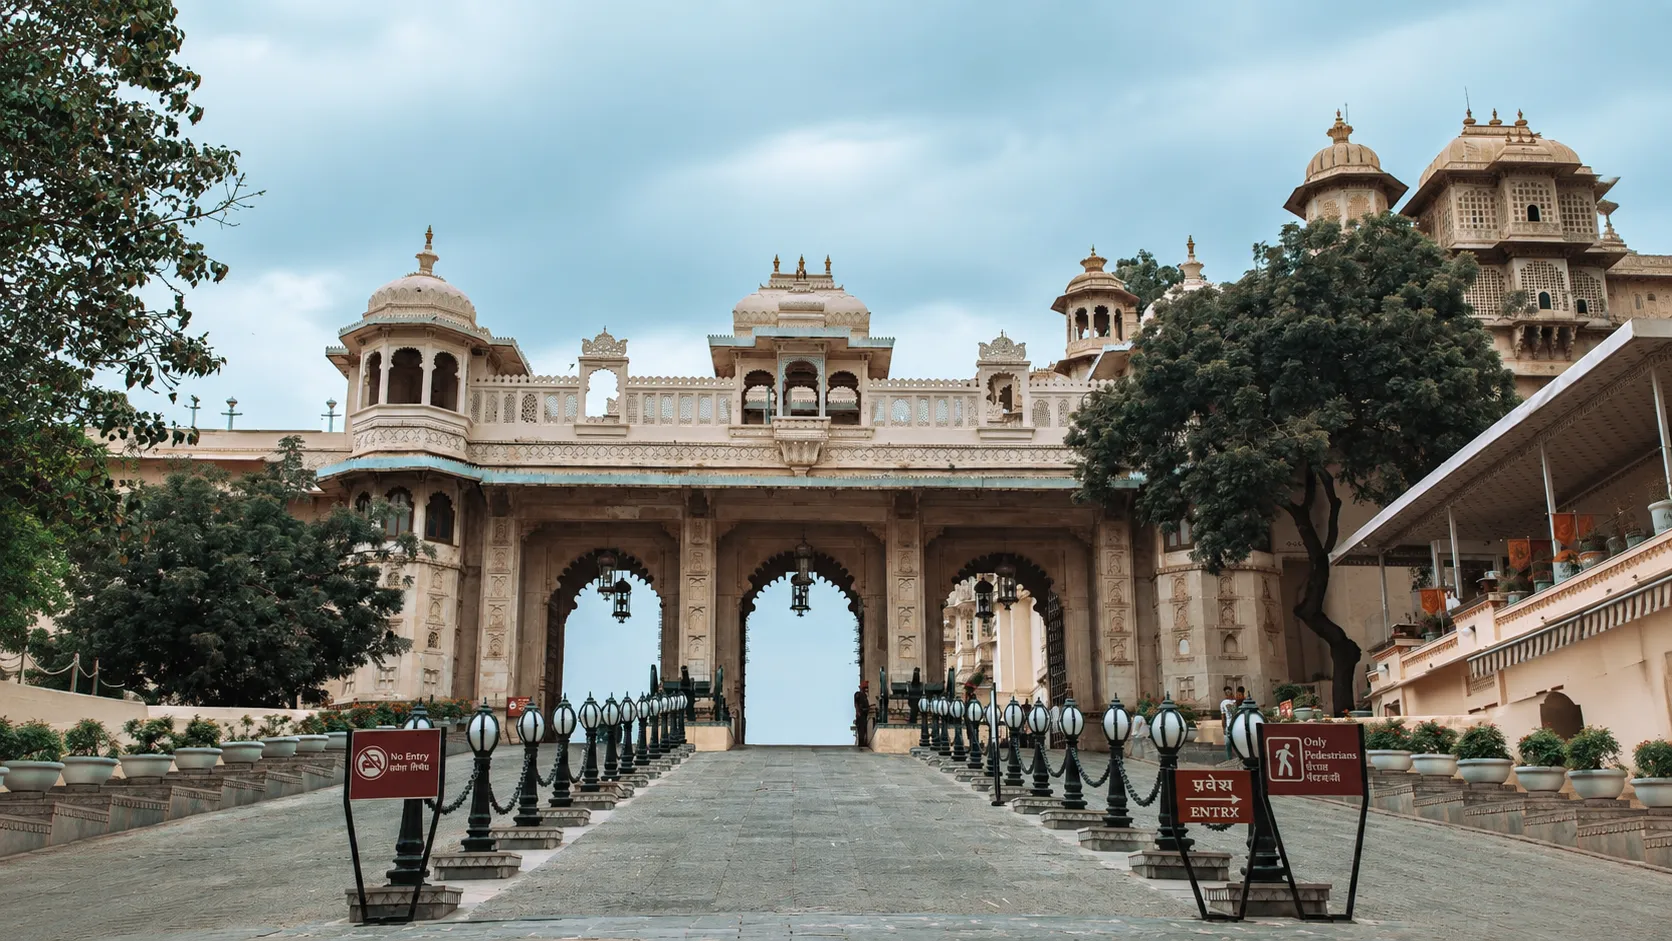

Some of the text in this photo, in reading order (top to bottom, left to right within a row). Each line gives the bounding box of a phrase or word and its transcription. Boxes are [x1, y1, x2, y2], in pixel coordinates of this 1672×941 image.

[1303, 736, 1327, 749] Only
[391, 752, 430, 762] No Entry
[1304, 750, 1357, 760] Pedestrians
